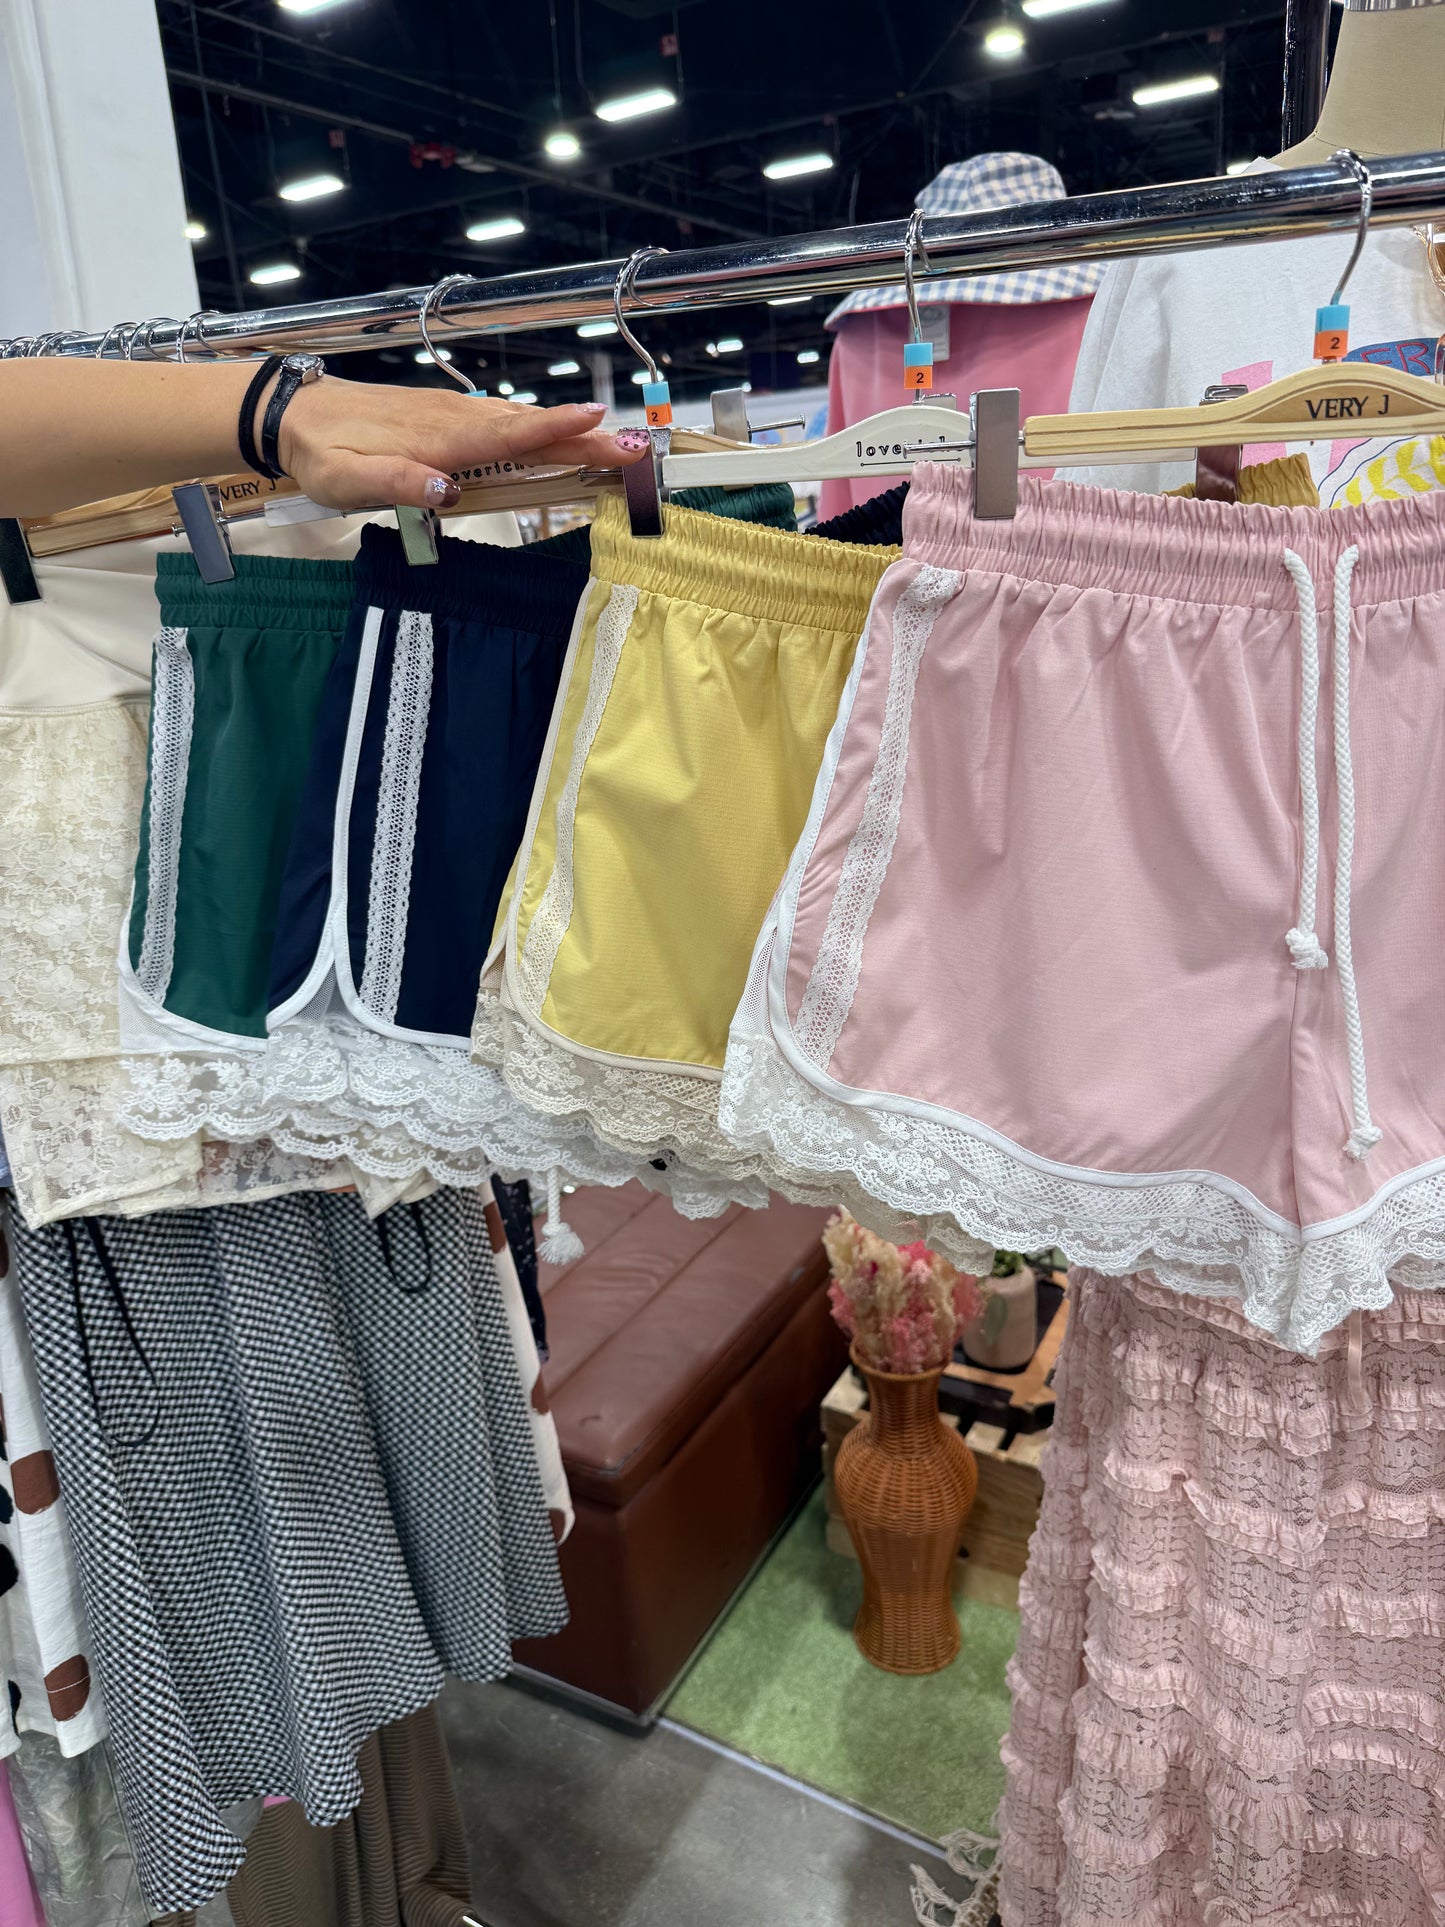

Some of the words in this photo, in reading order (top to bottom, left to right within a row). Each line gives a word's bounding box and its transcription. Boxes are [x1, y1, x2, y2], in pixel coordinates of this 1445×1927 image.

[1330, 336, 1341, 350] 2
[1360, 341, 1445, 375] ER
[916, 372, 925, 384] 2
[1305, 396, 1369, 419] VERY
[1377, 394, 1390, 416] J
[651, 411, 659, 422] 2
[220, 480, 260, 501] VERY
[269, 479, 278, 491] J
